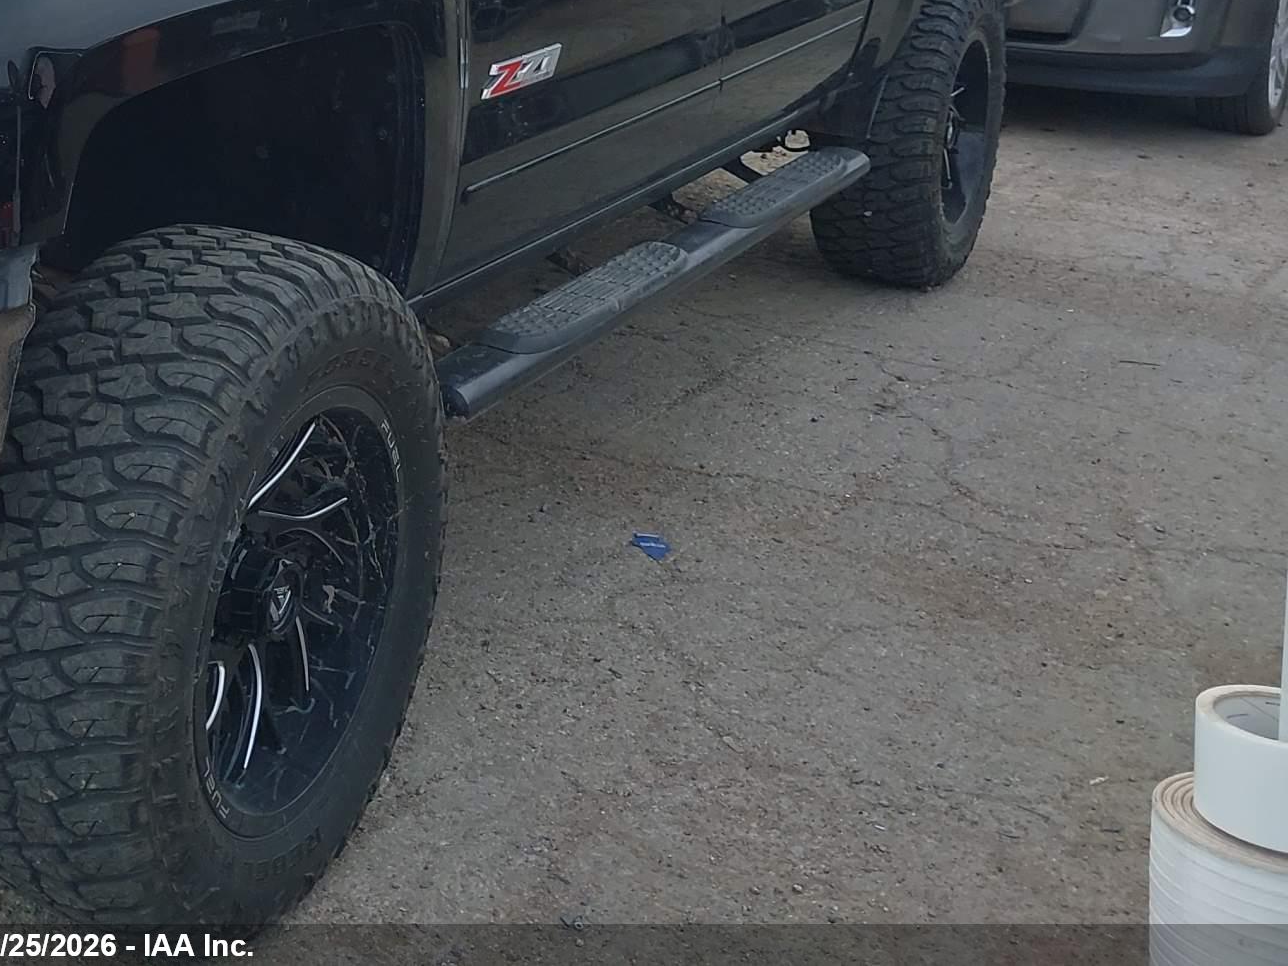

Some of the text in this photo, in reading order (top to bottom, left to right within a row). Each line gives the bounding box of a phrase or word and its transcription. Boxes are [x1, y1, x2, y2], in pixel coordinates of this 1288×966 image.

[481, 43, 562, 99] Z71
[380, 418, 402, 483] FUEL
[203, 756, 231, 819] FUEL
